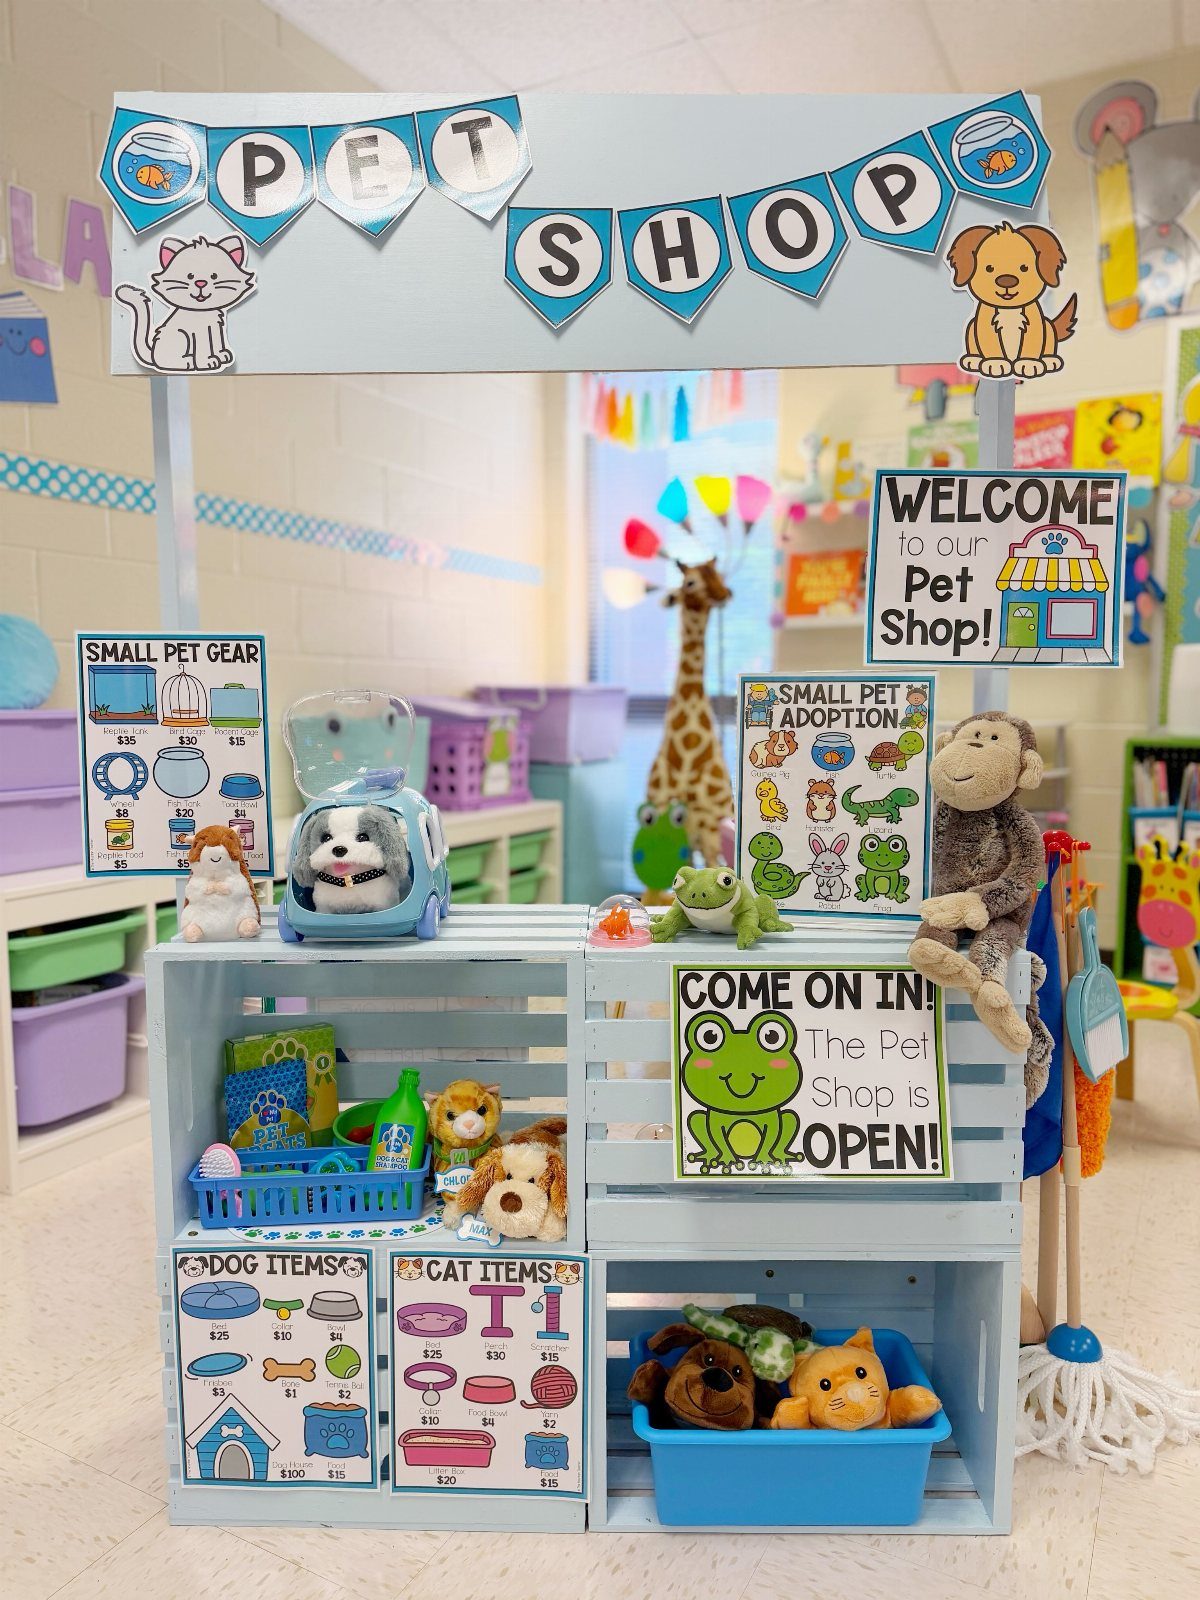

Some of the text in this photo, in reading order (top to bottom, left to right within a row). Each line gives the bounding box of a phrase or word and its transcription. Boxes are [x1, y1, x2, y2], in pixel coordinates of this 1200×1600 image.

[243, 116, 917, 286] PET SHOP
[886, 477, 1114, 525] WELCOME
[899, 530, 988, 556] to our
[904, 565, 973, 602] Pet
[880, 608, 992, 656] Shop!
[85, 642, 259, 664] SMALL PET GEAR
[779, 683, 901, 705] SMALL PET
[779, 707, 899, 729] ADOPTION
[103, 727, 130, 736] Reptile
[169, 727, 185, 735] Bird
[117, 736, 136, 746] $35
[178, 736, 198, 746] $30
[228, 736, 246, 747] $15
[875, 771, 896, 780] Turtle
[110, 800, 135, 808] Wheel
[167, 799, 183, 808] Fish
[115, 808, 129, 818] $8
[175, 808, 194, 818] $20
[234, 808, 247, 819] $4
[868, 826, 893, 834] Lizard
[114, 859, 128, 869] $5
[177, 858, 190, 869] $5
[873, 903, 892, 912] Frog
[680, 972, 934, 1011] COME ON IN!
[805, 1028, 929, 1060] The Pet
[812, 1076, 930, 1117] Shop is
[253, 1122, 289, 1145] PET
[803, 1122, 940, 1170] OPEN!
[375, 1161, 408, 1170] SHAMPOO
[469, 1223, 493, 1236] MAX
[209, 1254, 338, 1276] DOG ITEMS
[426, 1260, 553, 1283] CAT ITEMS
[211, 1322, 227, 1330] Bed
[271, 1322, 294, 1330] Collar
[327, 1323, 346, 1332] Bowl
[209, 1330, 230, 1341] $25
[273, 1331, 292, 1341] $10
[329, 1332, 343, 1342] $4
[425, 1340, 441, 1349] Bed
[484, 1341, 508, 1350] Perch
[530, 1342, 569, 1351] Scratcher
[422, 1349, 443, 1360] $25
[486, 1350, 506, 1361] $30
[540, 1352, 559, 1362] $15
[281, 1379, 300, 1388] Bone
[351, 1381, 364, 1390] Ball
[212, 1387, 226, 1397] $3
[285, 1388, 297, 1398] $1
[338, 1389, 351, 1400] $2
[468, 1408, 508, 1417] Food Bowl
[540, 1410, 559, 1419] Yarn
[421, 1415, 439, 1426] $10
[481, 1417, 495, 1427] $4
[543, 1418, 556, 1429] $2
[272, 1460, 314, 1470] Dog House
[327, 1461, 346, 1470] Food
[280, 1469, 305, 1479] $100
[328, 1469, 346, 1480] $15
[428, 1466, 465, 1475] Litter Box
[540, 1470, 558, 1478] Food
[436, 1475, 456, 1486] $20
[540, 1478, 559, 1488] $15
